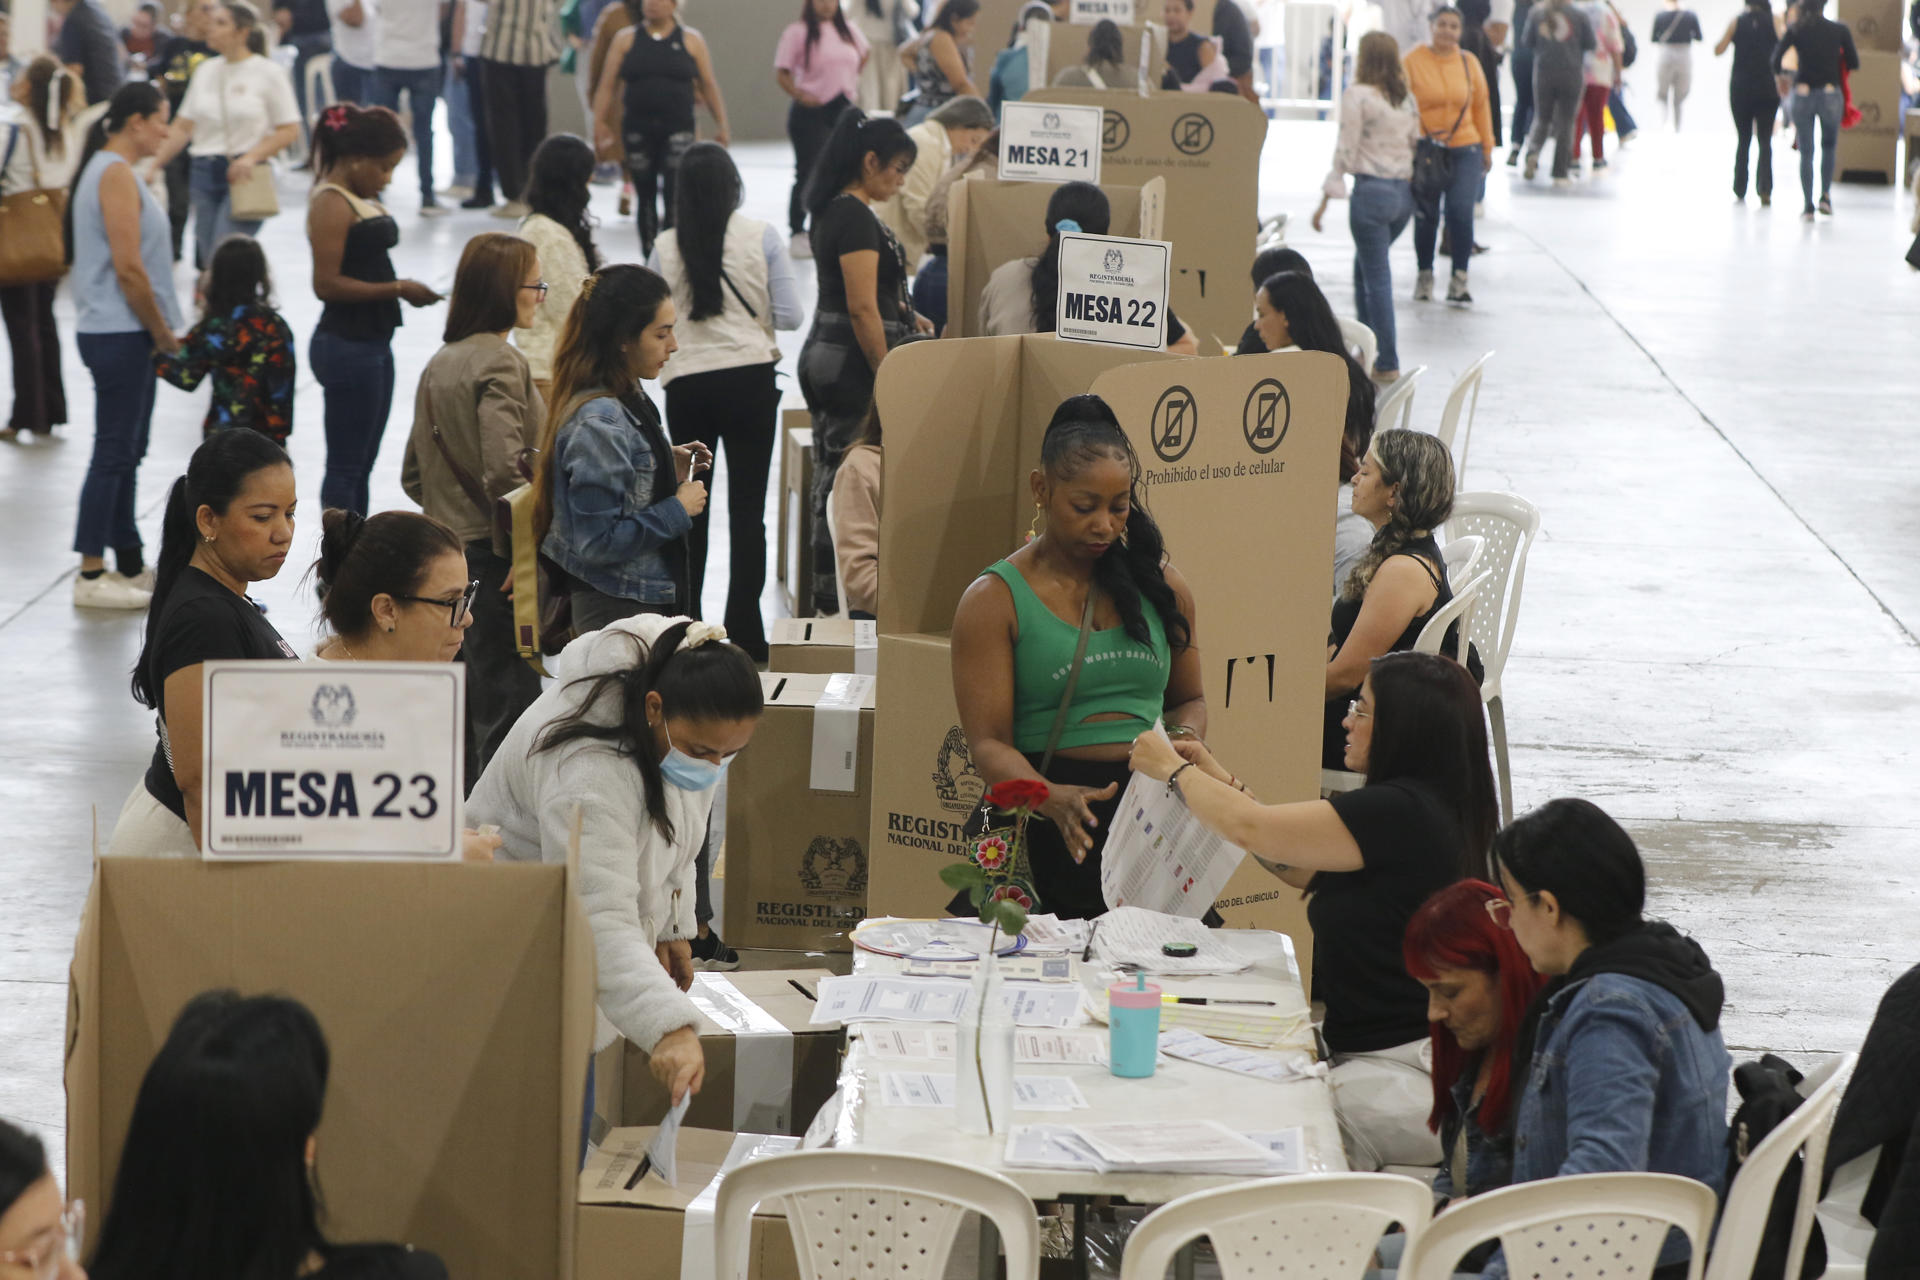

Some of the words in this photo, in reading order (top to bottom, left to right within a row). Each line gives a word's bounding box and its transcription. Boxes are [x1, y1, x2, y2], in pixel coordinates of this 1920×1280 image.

[1007, 145, 1060, 166] MESA
[1065, 148, 1089, 167] 21
[1065, 292, 1122, 324] MESA
[1126, 299, 1156, 328] 22
[1146, 465, 1197, 486] Prohibido
[1200, 464, 1210, 480] el
[1213, 466, 1231, 479] uso
[1233, 461, 1246, 476] de
[1249, 458, 1285, 475] celular
[1084, 650, 1123, 664] WORRY
[225, 771, 359, 817] MESA
[371, 772, 438, 819] 23
[888, 832, 943, 853] NACIONAL
[1231, 897, 1244, 907] DEL
[757, 916, 809, 927] NACIONAL
[812, 918, 834, 928] DEL
